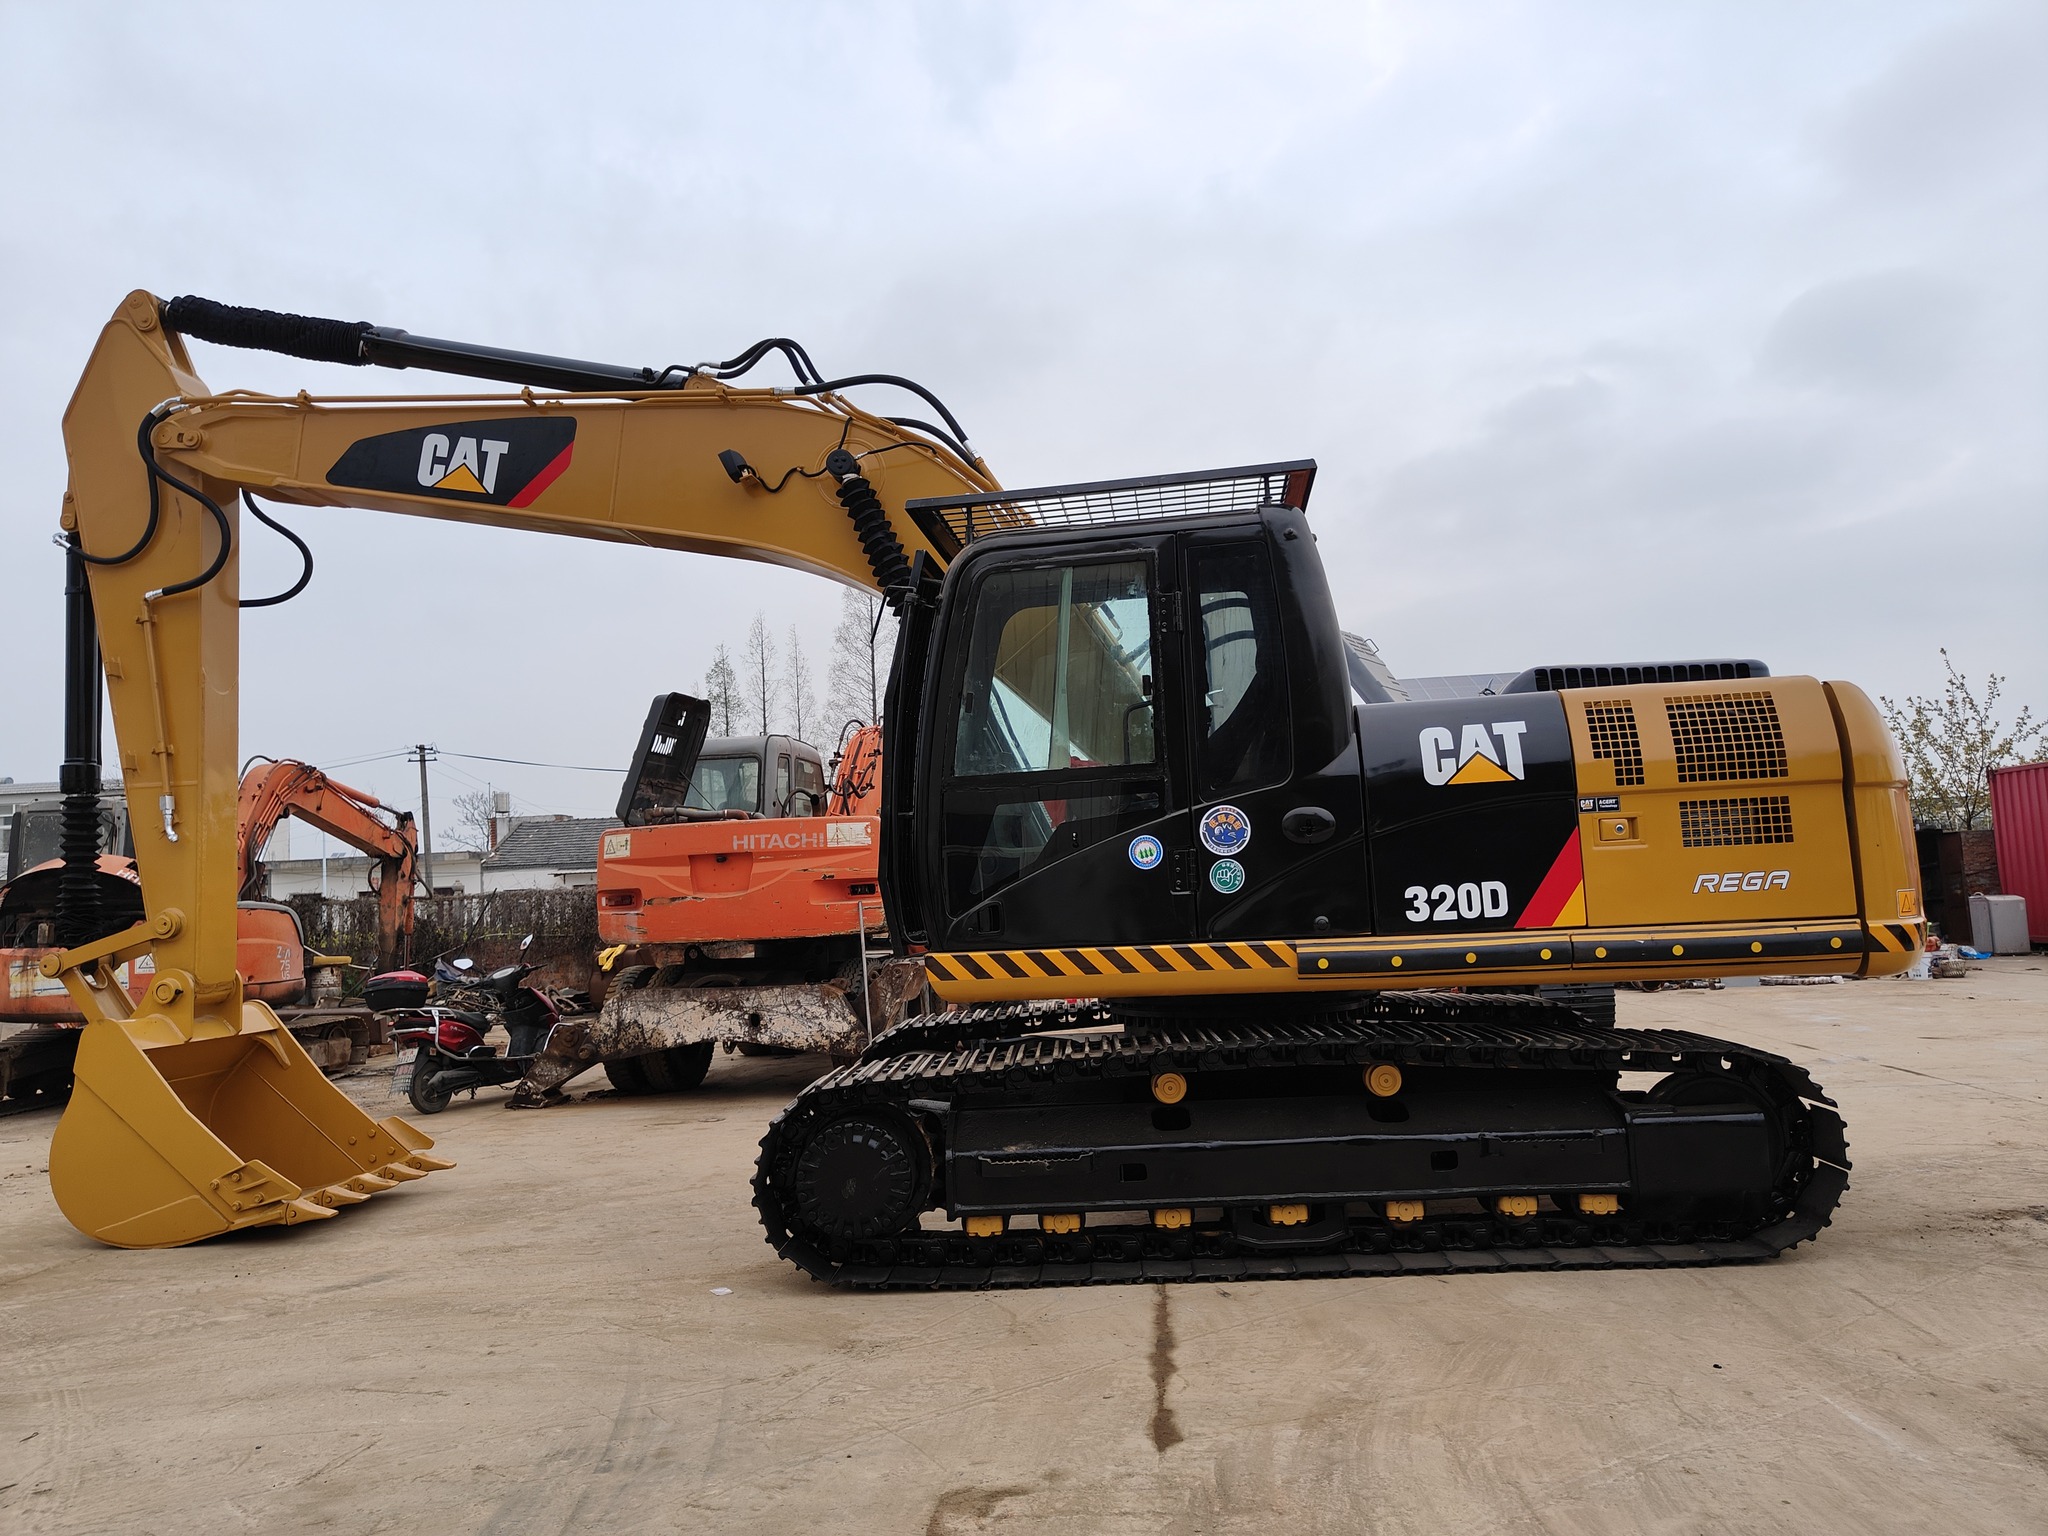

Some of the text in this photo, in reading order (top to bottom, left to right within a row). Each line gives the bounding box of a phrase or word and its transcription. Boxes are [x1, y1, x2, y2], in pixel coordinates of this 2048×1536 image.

[417, 433, 509, 495] CAT
[1419, 721, 1527, 785] CAT
[1580, 799, 1594, 808] CAT
[732, 832, 824, 850] HITACHI
[1692, 870, 1791, 894] REGA
[1404, 881, 1508, 922] 320D
[280, 960, 291, 971] 75
